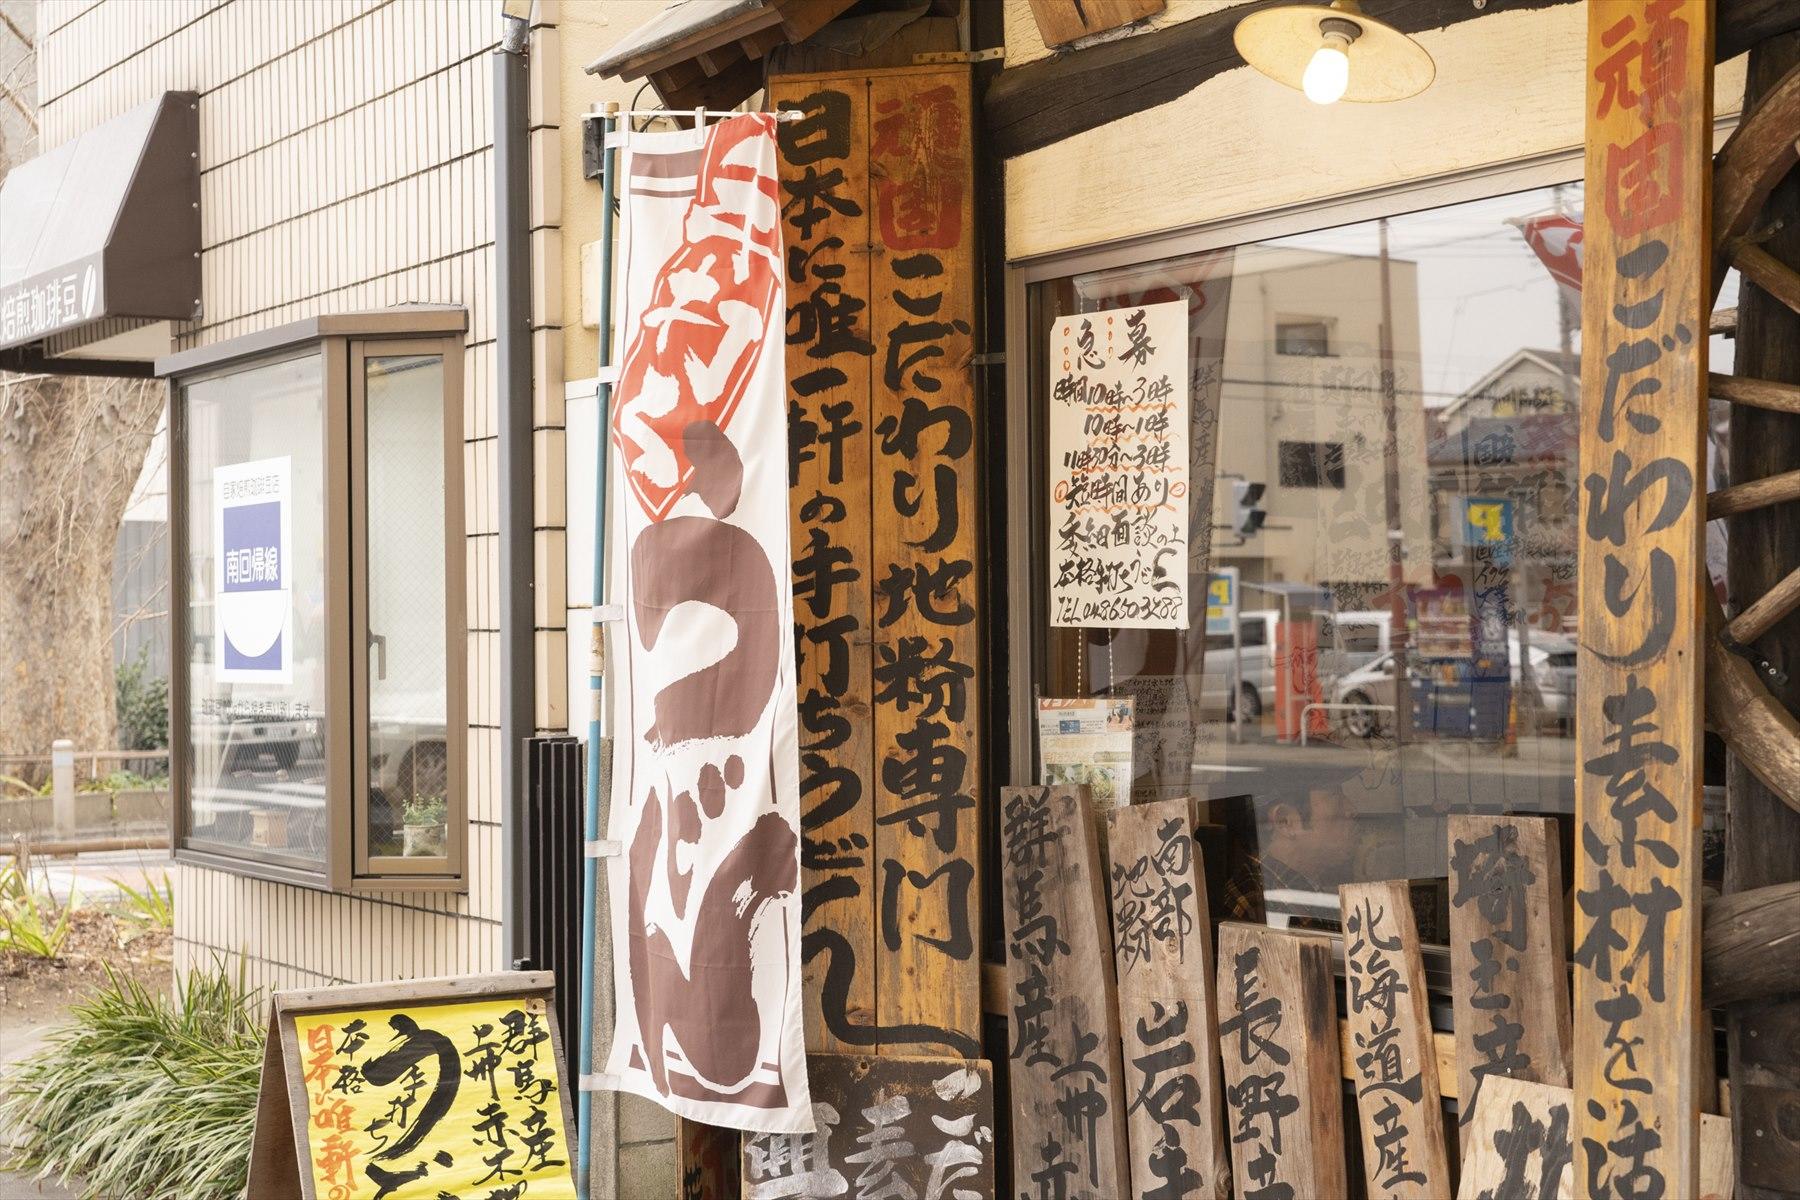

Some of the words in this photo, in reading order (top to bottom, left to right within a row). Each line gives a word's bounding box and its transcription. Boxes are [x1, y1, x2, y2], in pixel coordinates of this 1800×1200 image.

[1076, 309, 1157, 373] 急募
[1066, 471, 1168, 510] 短時間あり
[226, 546, 279, 585] 南回帰線
[1057, 596, 1081, 623] TEL
[1151, 817, 1193, 965] 南部
[496, 1009, 567, 1171] 群馬産
